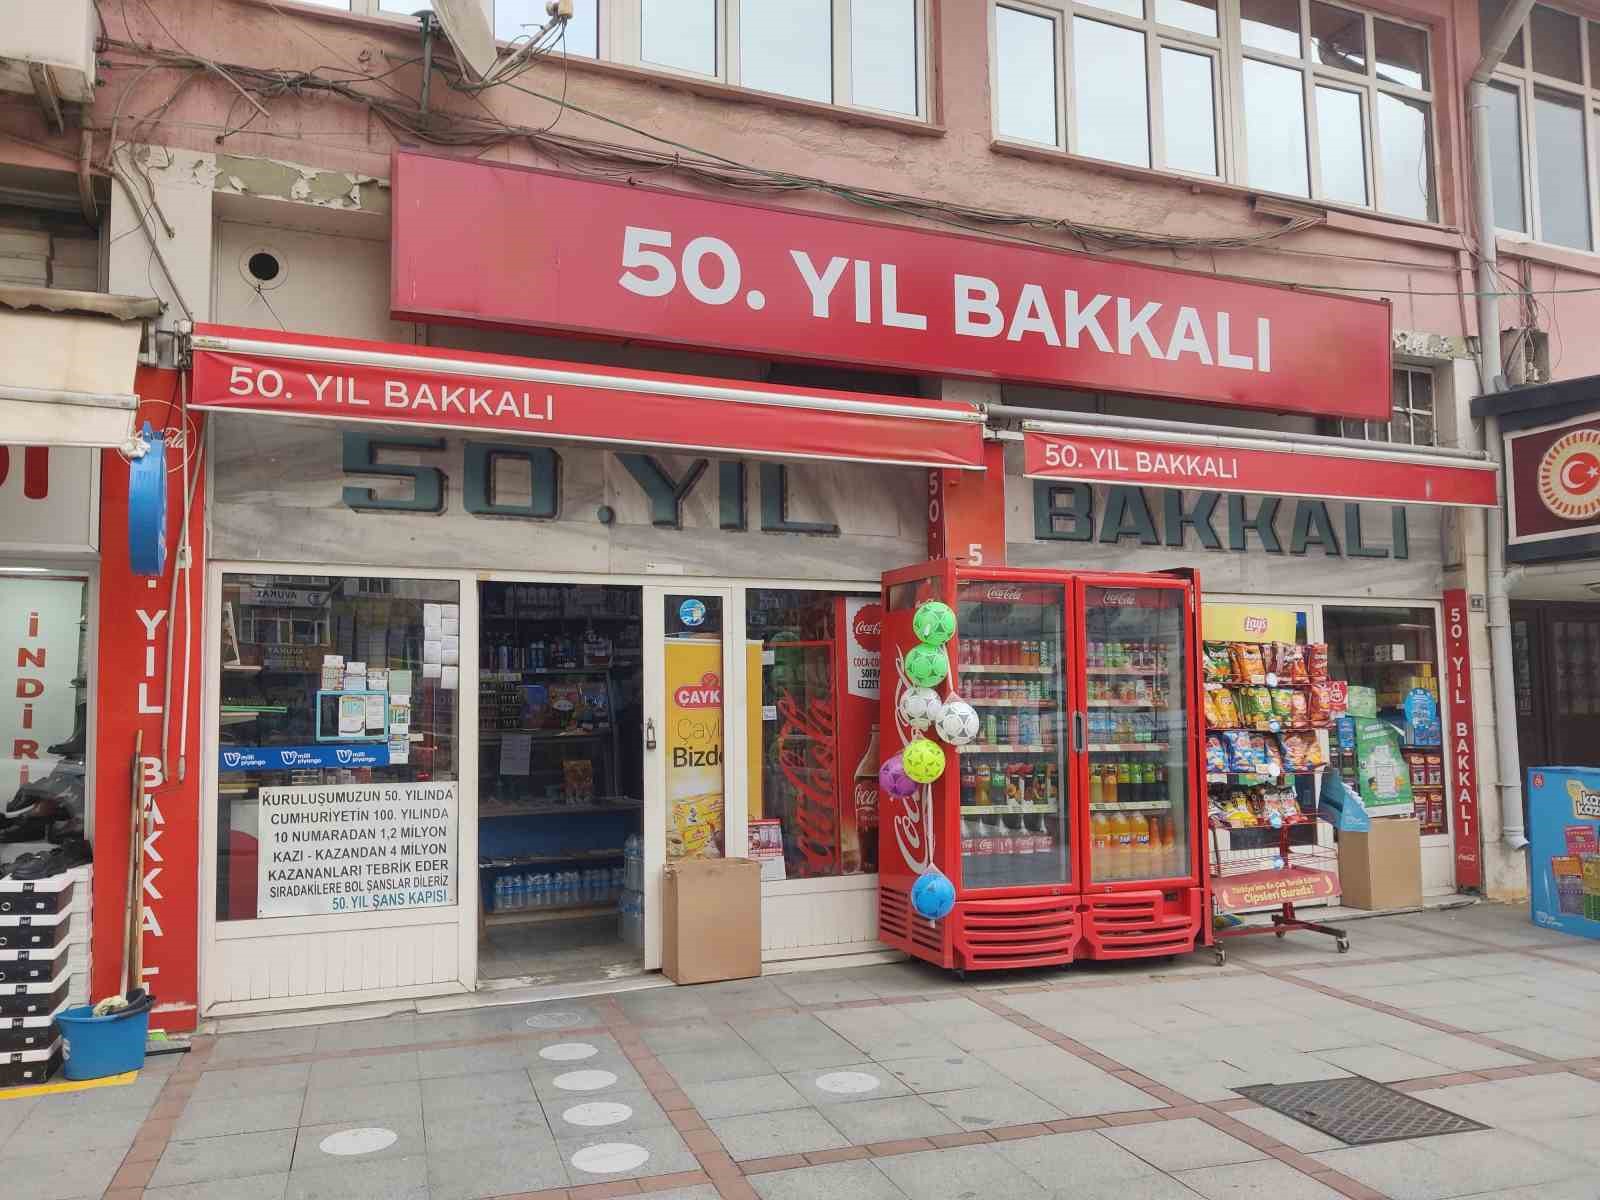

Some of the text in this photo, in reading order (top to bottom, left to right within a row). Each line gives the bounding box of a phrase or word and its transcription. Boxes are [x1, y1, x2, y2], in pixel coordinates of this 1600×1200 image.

[618, 225, 1272, 373] 50. YIL BAKKALI
[228, 366, 553, 421] 50. YIL BAKKALI
[1045, 443, 1238, 479] 50. YIL BAKKALI
[1033, 479, 1409, 560] BAKKALI
[1451, 607, 1463, 648] 50.
[136, 609, 168, 714] YIL
[1455, 722, 1472, 836] BAKKALI
[262, 788, 454, 807] KURULUŞUMUZUN 50. YILINDA
[271, 807, 449, 825] CUMHURİYETİN 100. YILINDA
[274, 824, 447, 843] 10 NUMARADAN 1,2 MİLYON
[273, 850, 304, 864] KAZI
[315, 846, 387, 861] KAZANDAN
[390, 845, 397, 857] 4
[401, 843, 447, 856] MİLYON
[268, 859, 449, 882] KAZANANLARI TEBRİK EDER
[270, 874, 449, 898] SIRADAKİLERE BOL ŞANSLAR DİLERİZ
[332, 889, 447, 911] 50. YIL ŞANS KAPISI
